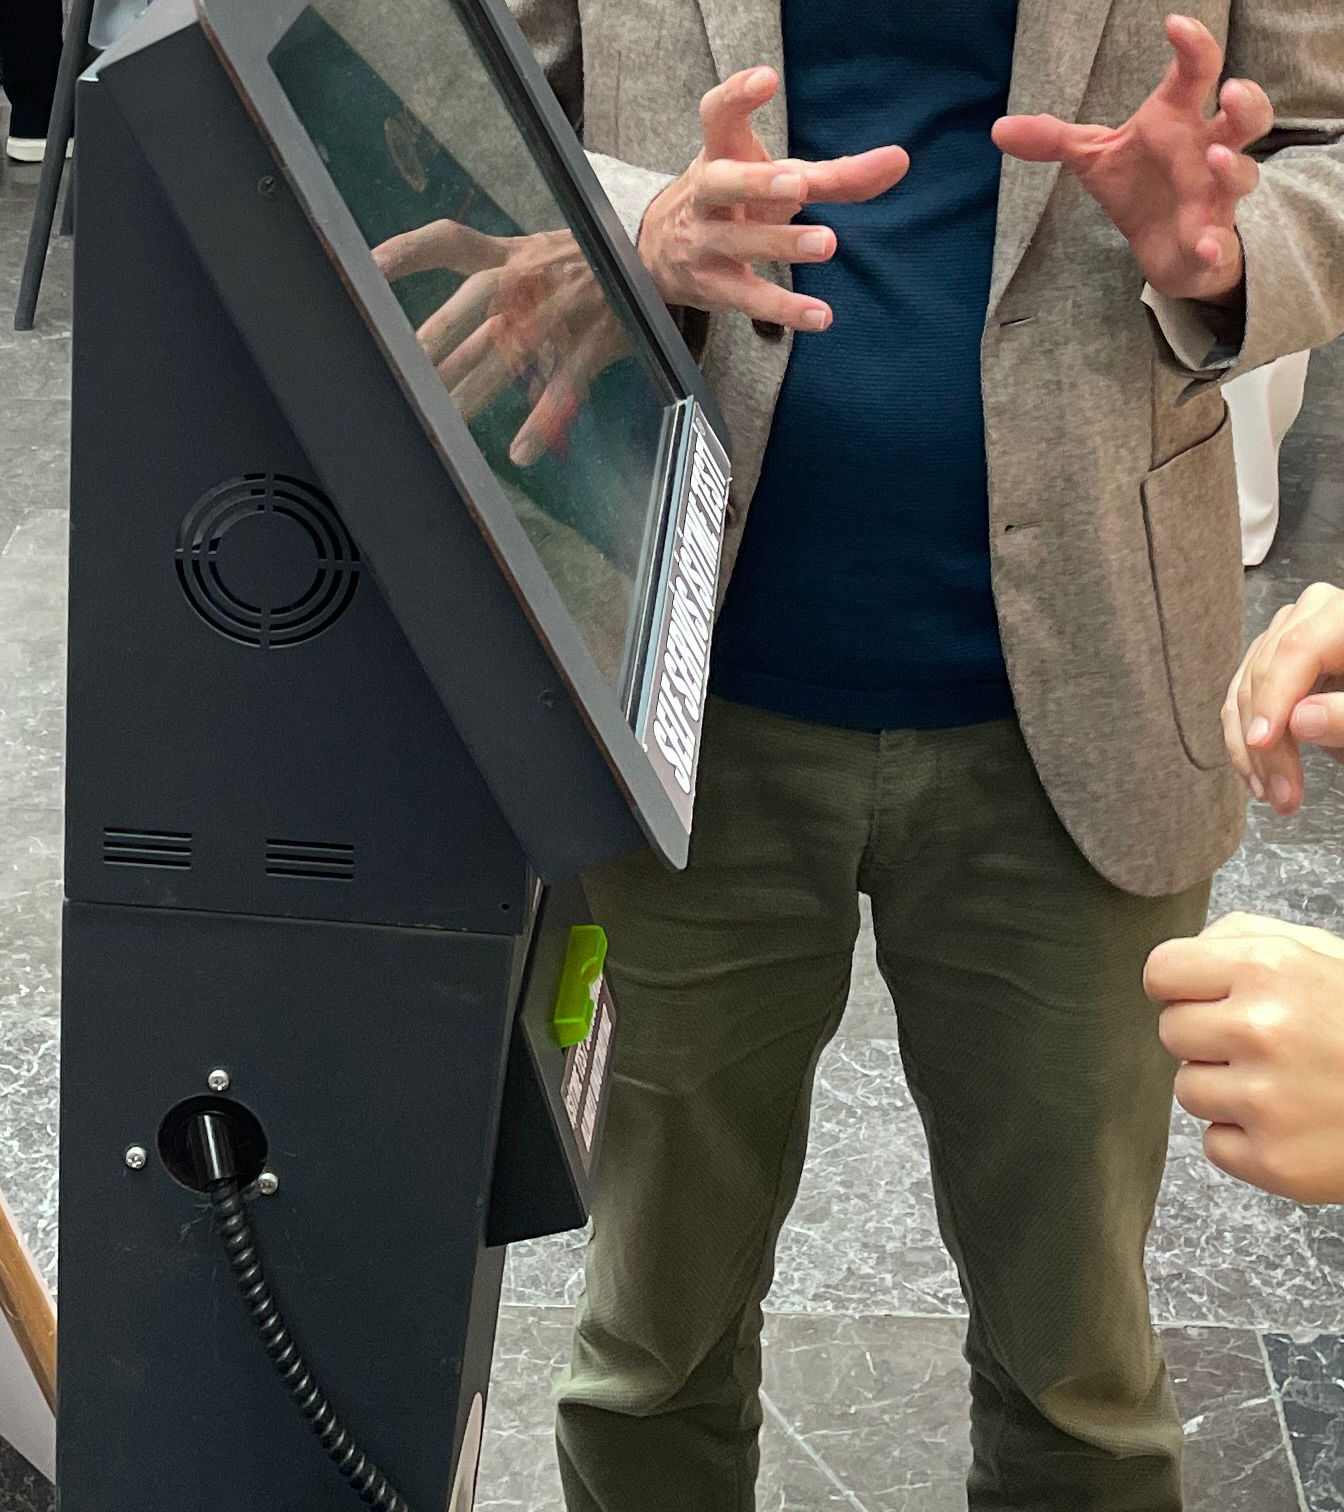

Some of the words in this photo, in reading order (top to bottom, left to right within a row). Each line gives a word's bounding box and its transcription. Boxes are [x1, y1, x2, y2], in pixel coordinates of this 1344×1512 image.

[690, 423, 726, 535] TESTİ
[674, 491, 719, 622] İŞİTME
[664, 575, 707, 722] SERVİS
[653, 672, 695, 794] SELF
